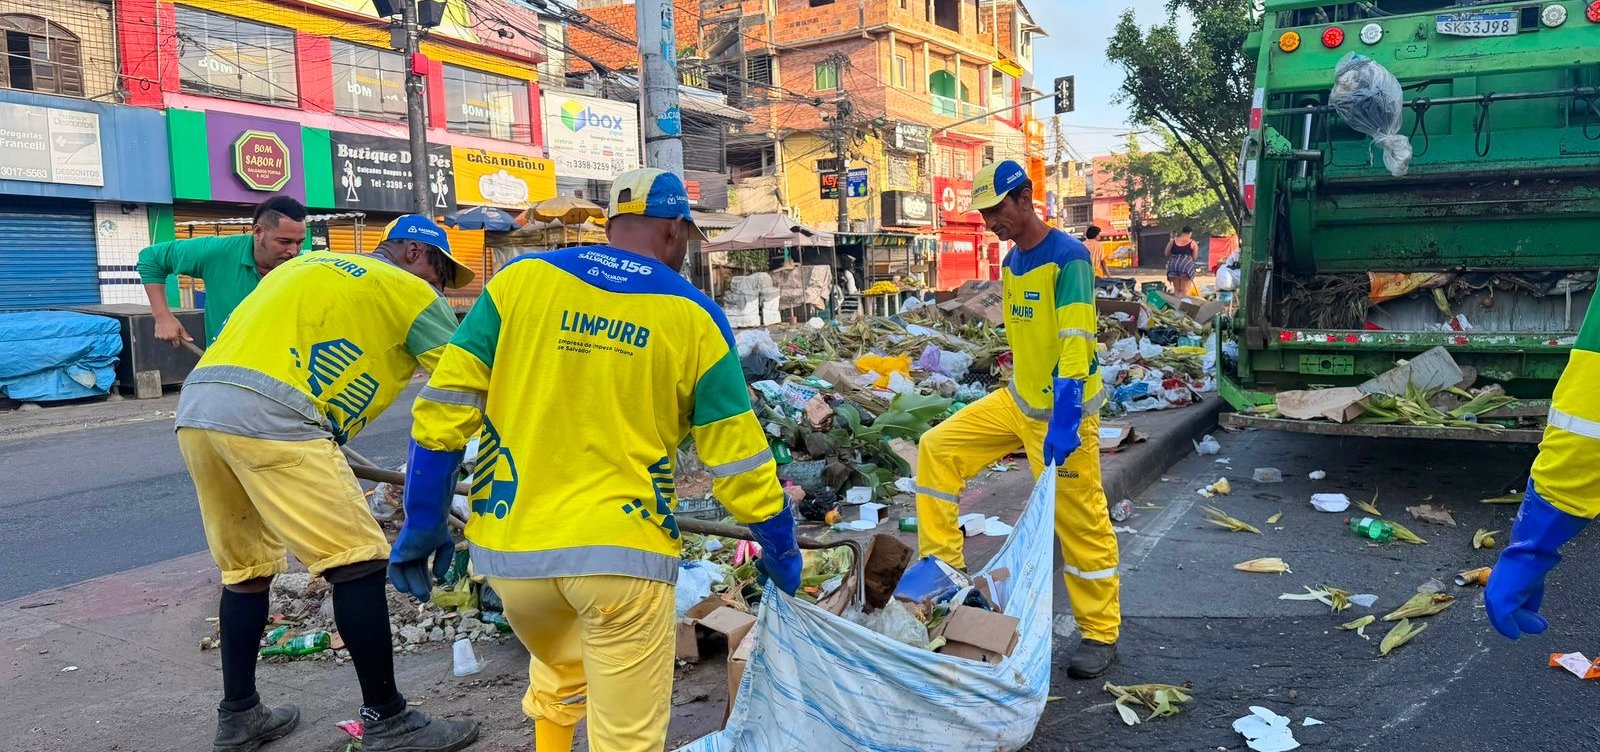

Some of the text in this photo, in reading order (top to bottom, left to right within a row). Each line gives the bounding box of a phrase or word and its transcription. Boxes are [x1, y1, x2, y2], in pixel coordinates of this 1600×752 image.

[1444, 20, 1509, 34] SKS3J98
[588, 106, 622, 130] box
[255, 144, 272, 153] BOM
[337, 144, 398, 164] Butique
[428, 154, 451, 168] Pés
[245, 155, 274, 168] SABOR
[467, 153, 545, 171] CASA DO BOLO
[578, 253, 653, 276] SALVADOR 156
[560, 310, 650, 348] LIMPURB
[565, 345, 592, 354] Salvador
